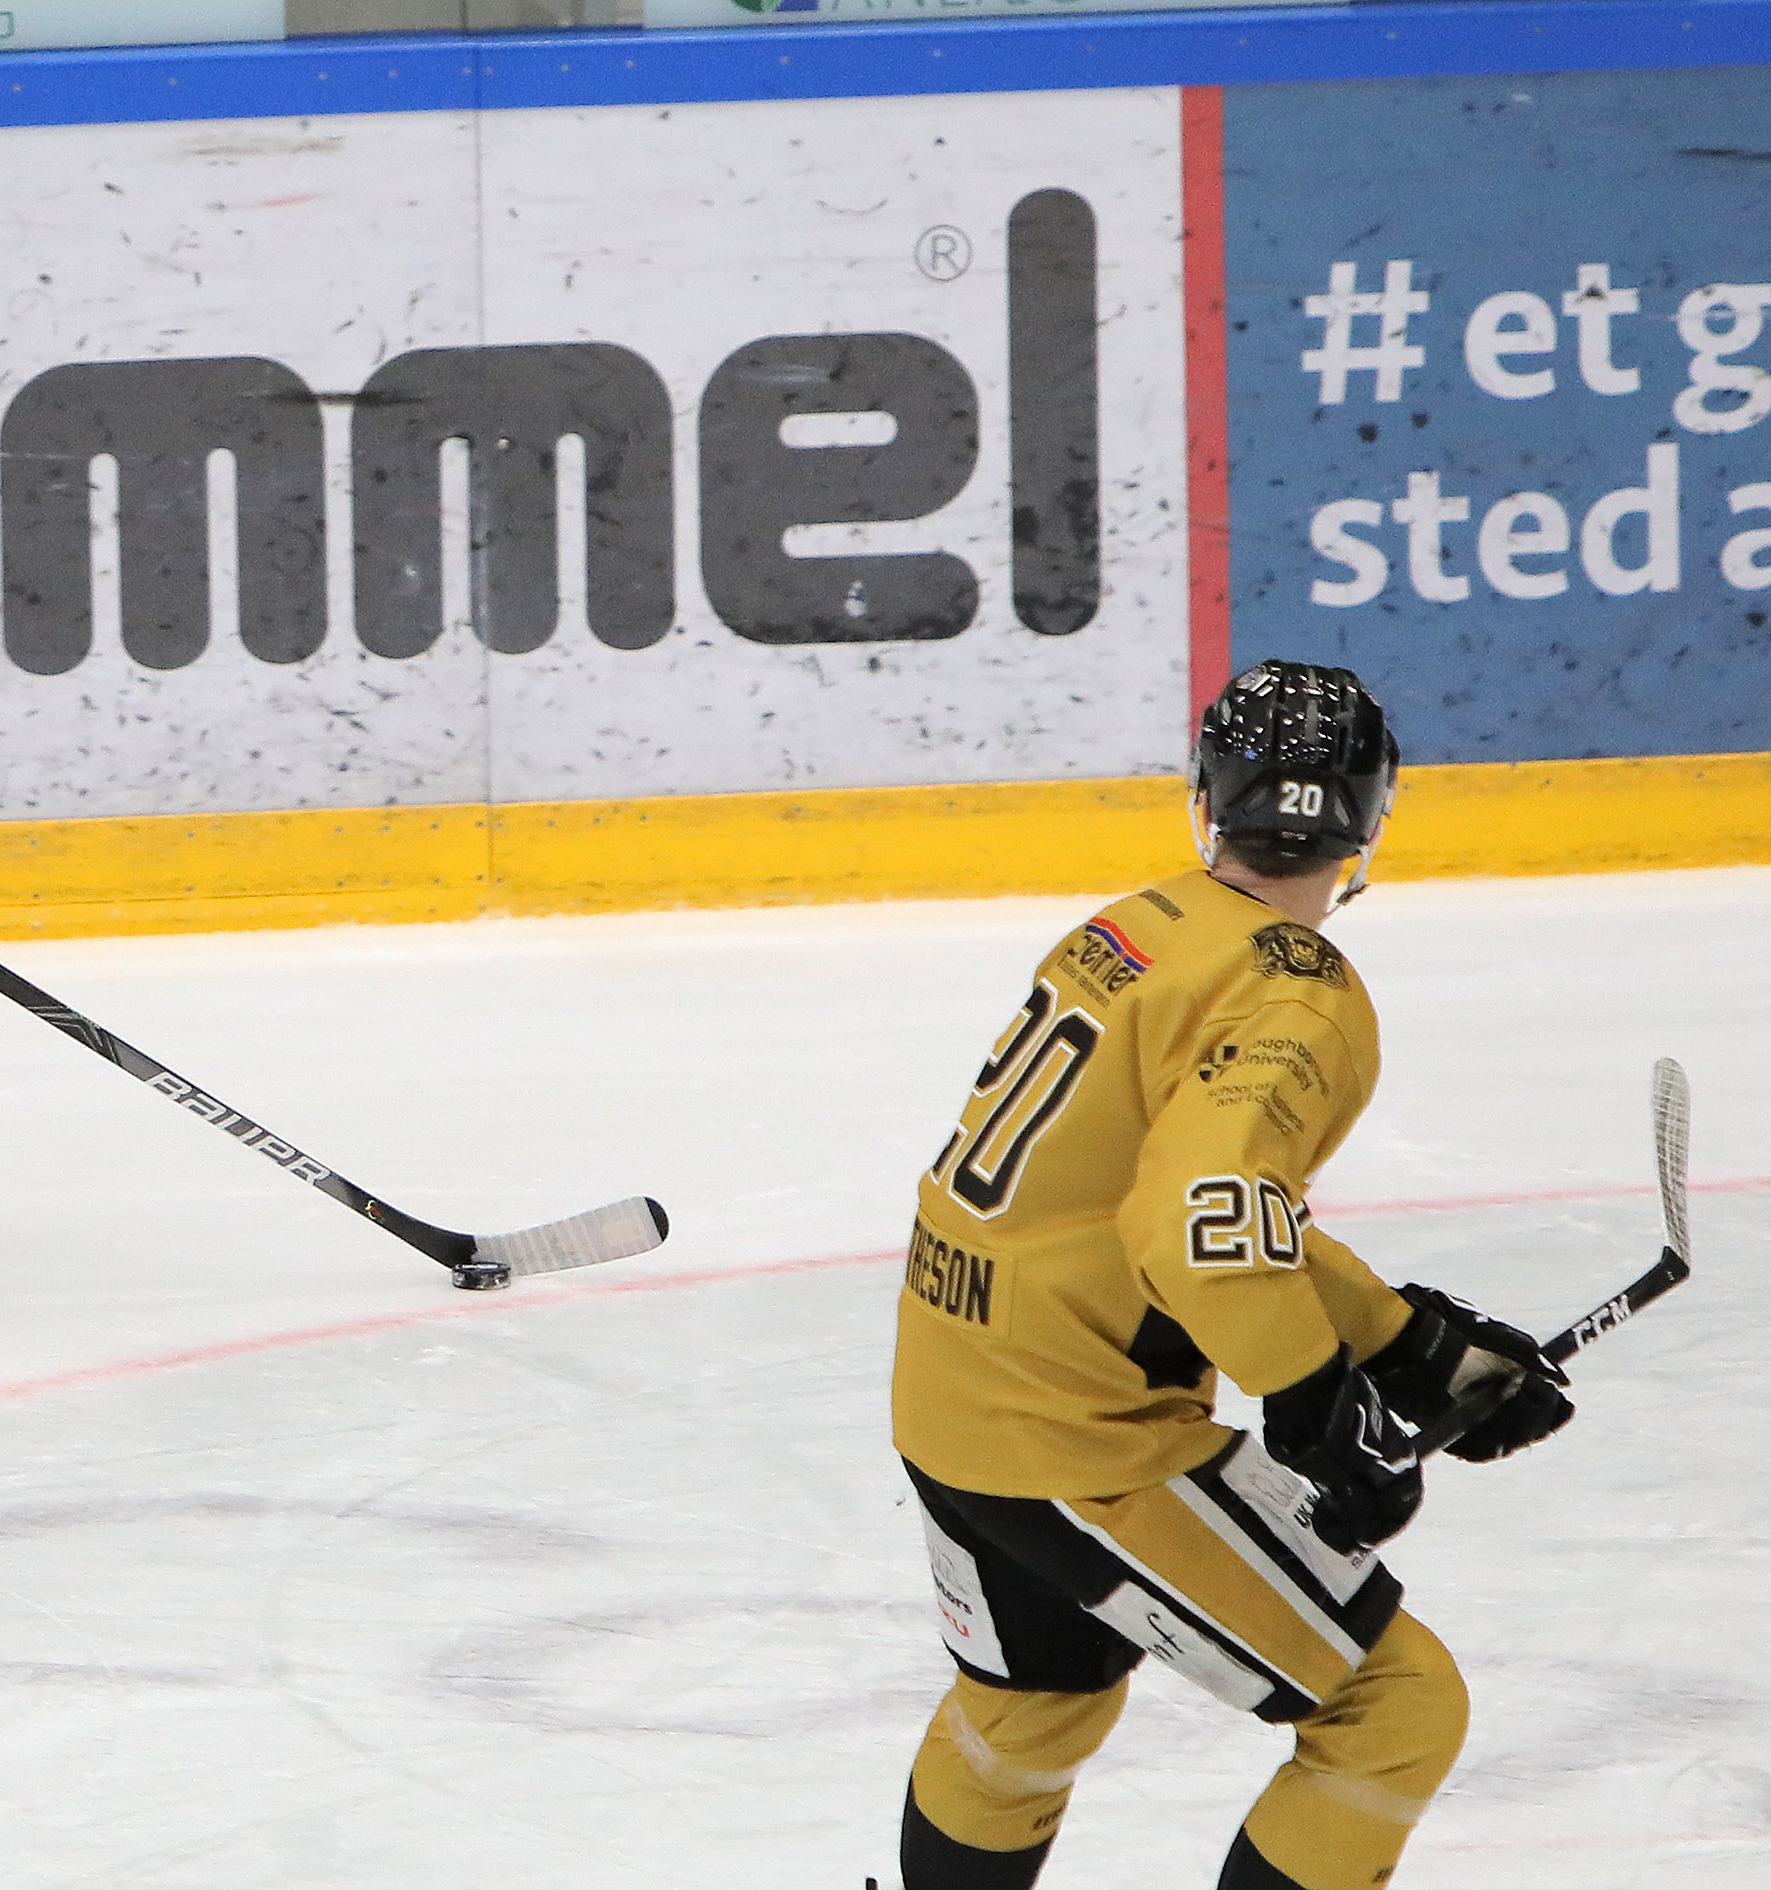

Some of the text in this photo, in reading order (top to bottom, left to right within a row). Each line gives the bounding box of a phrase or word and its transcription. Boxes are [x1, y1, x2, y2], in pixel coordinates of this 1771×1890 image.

[1464, 262, 1641, 400] et
[1309, 442, 1682, 607] sted
[1278, 780, 1325, 818] 20
[145, 1069, 332, 1186] BAUER
[906, 1216, 995, 1327] HESON
[1184, 1172, 1314, 1272] 20
